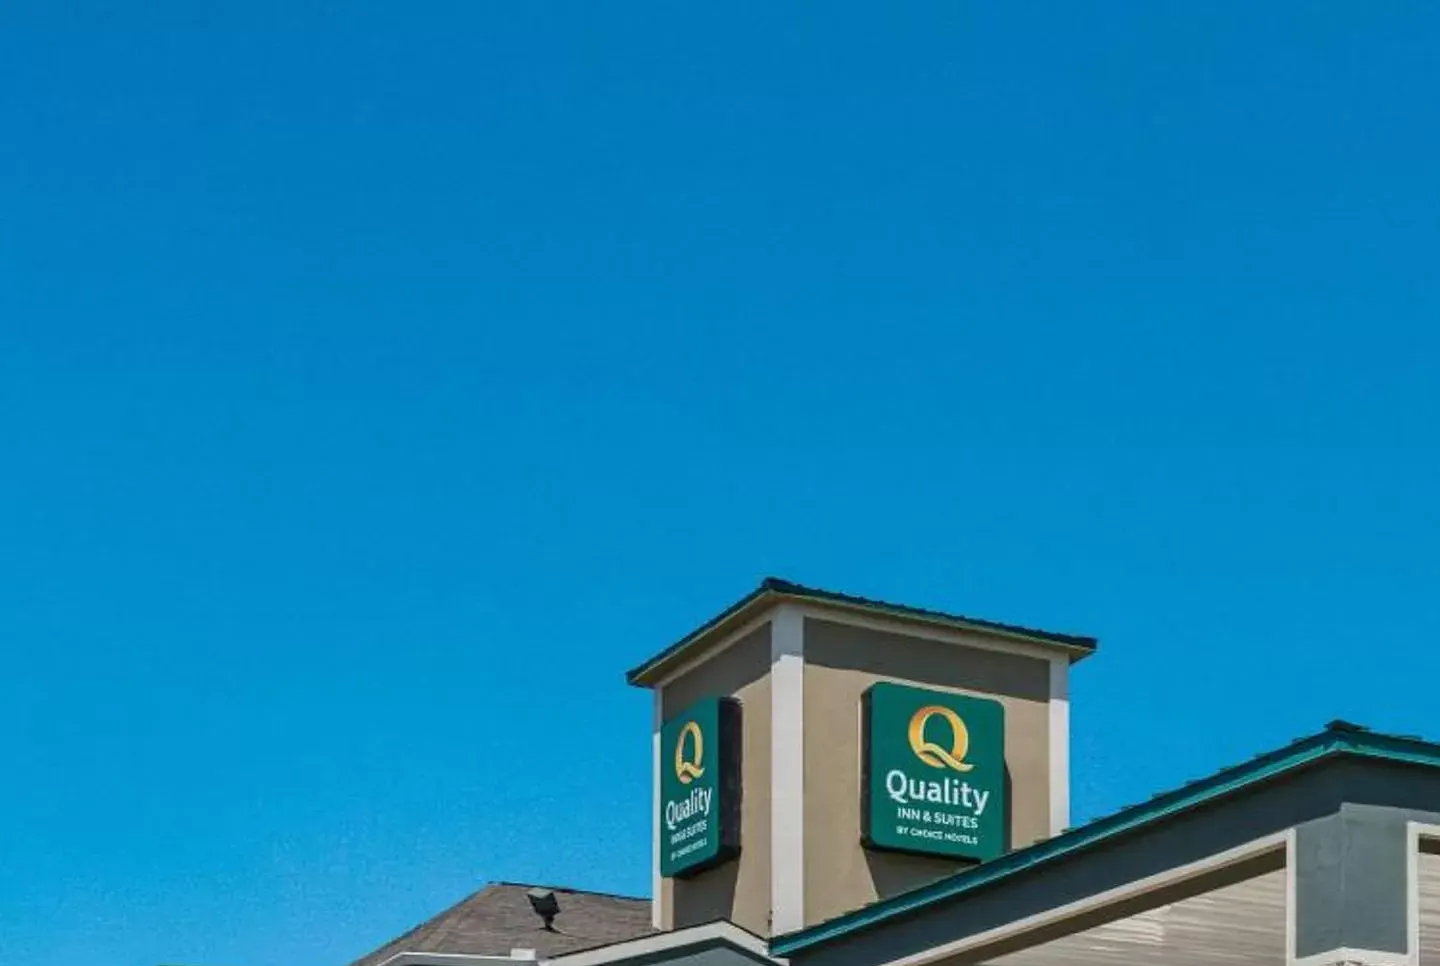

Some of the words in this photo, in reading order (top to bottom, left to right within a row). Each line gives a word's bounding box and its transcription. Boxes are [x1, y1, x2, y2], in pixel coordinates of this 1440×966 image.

[675, 721, 705, 784] Q
[908, 705, 974, 772] Q
[666, 786, 713, 830] Quality
[886, 769, 990, 815] Quality
[896, 807, 921, 820] INN
[923, 810, 932, 822] &
[933, 811, 979, 829] SUITES
